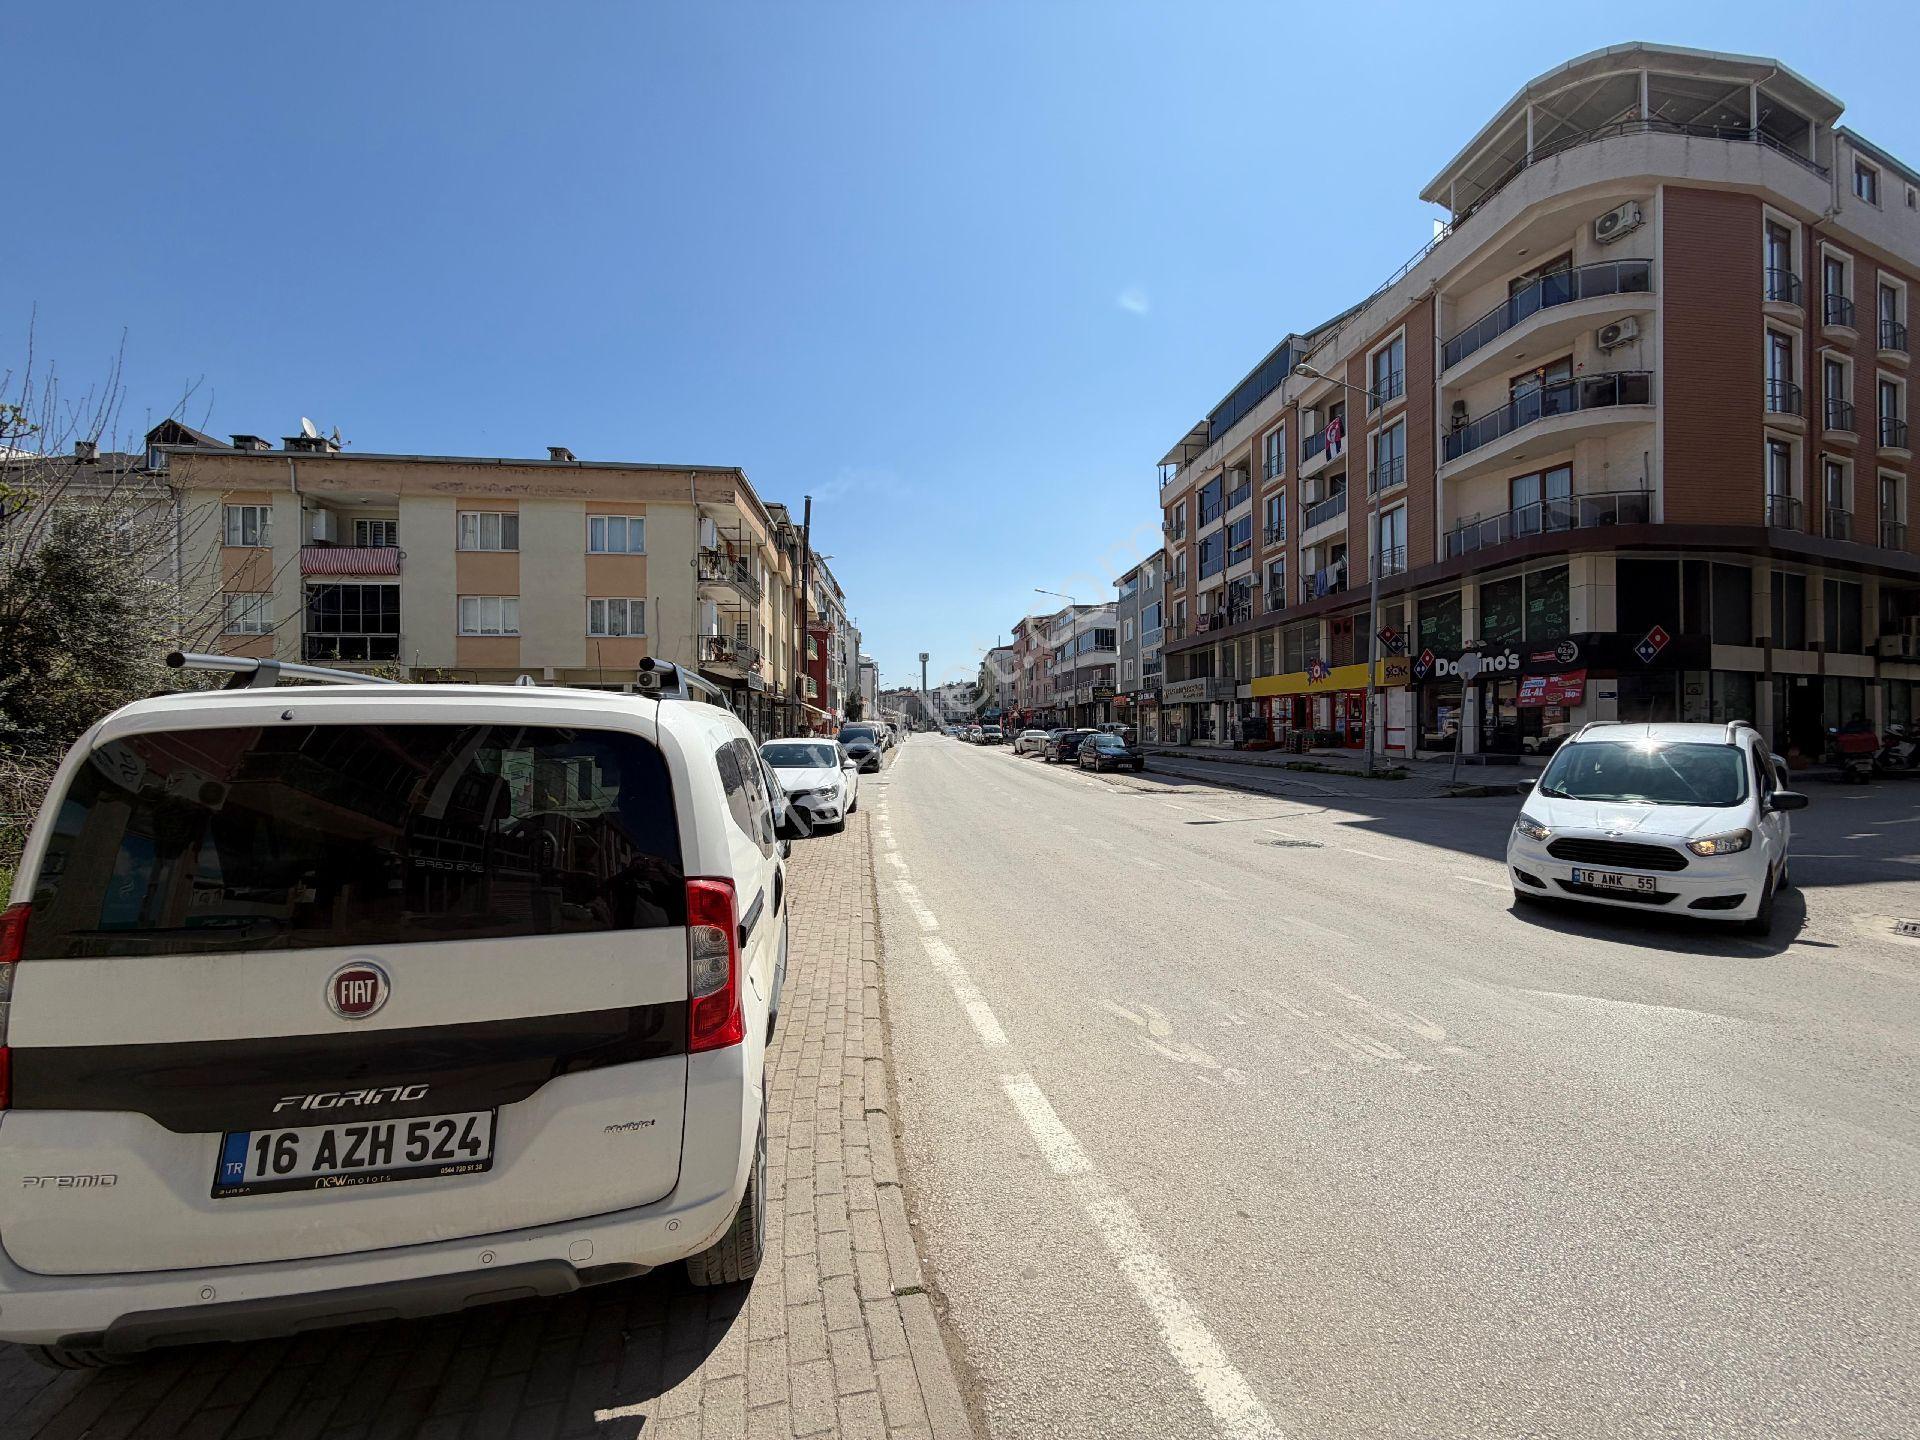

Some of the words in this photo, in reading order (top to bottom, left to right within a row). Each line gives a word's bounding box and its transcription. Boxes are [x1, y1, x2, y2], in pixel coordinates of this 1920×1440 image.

[1435, 648, 1520, 677] Doino's
[1519, 687, 1544, 697] GEL-AL
[1582, 871, 1595, 882] 16
[1601, 874, 1623, 886] ANK
[1637, 878, 1653, 889] 55
[340, 979, 376, 1004] FIAT
[272, 1083, 430, 1113] FIORINO
[254, 1132, 299, 1176] 16
[311, 1124, 395, 1171] AZH
[405, 1116, 482, 1162] 524
[226, 1162, 243, 1175] TR
